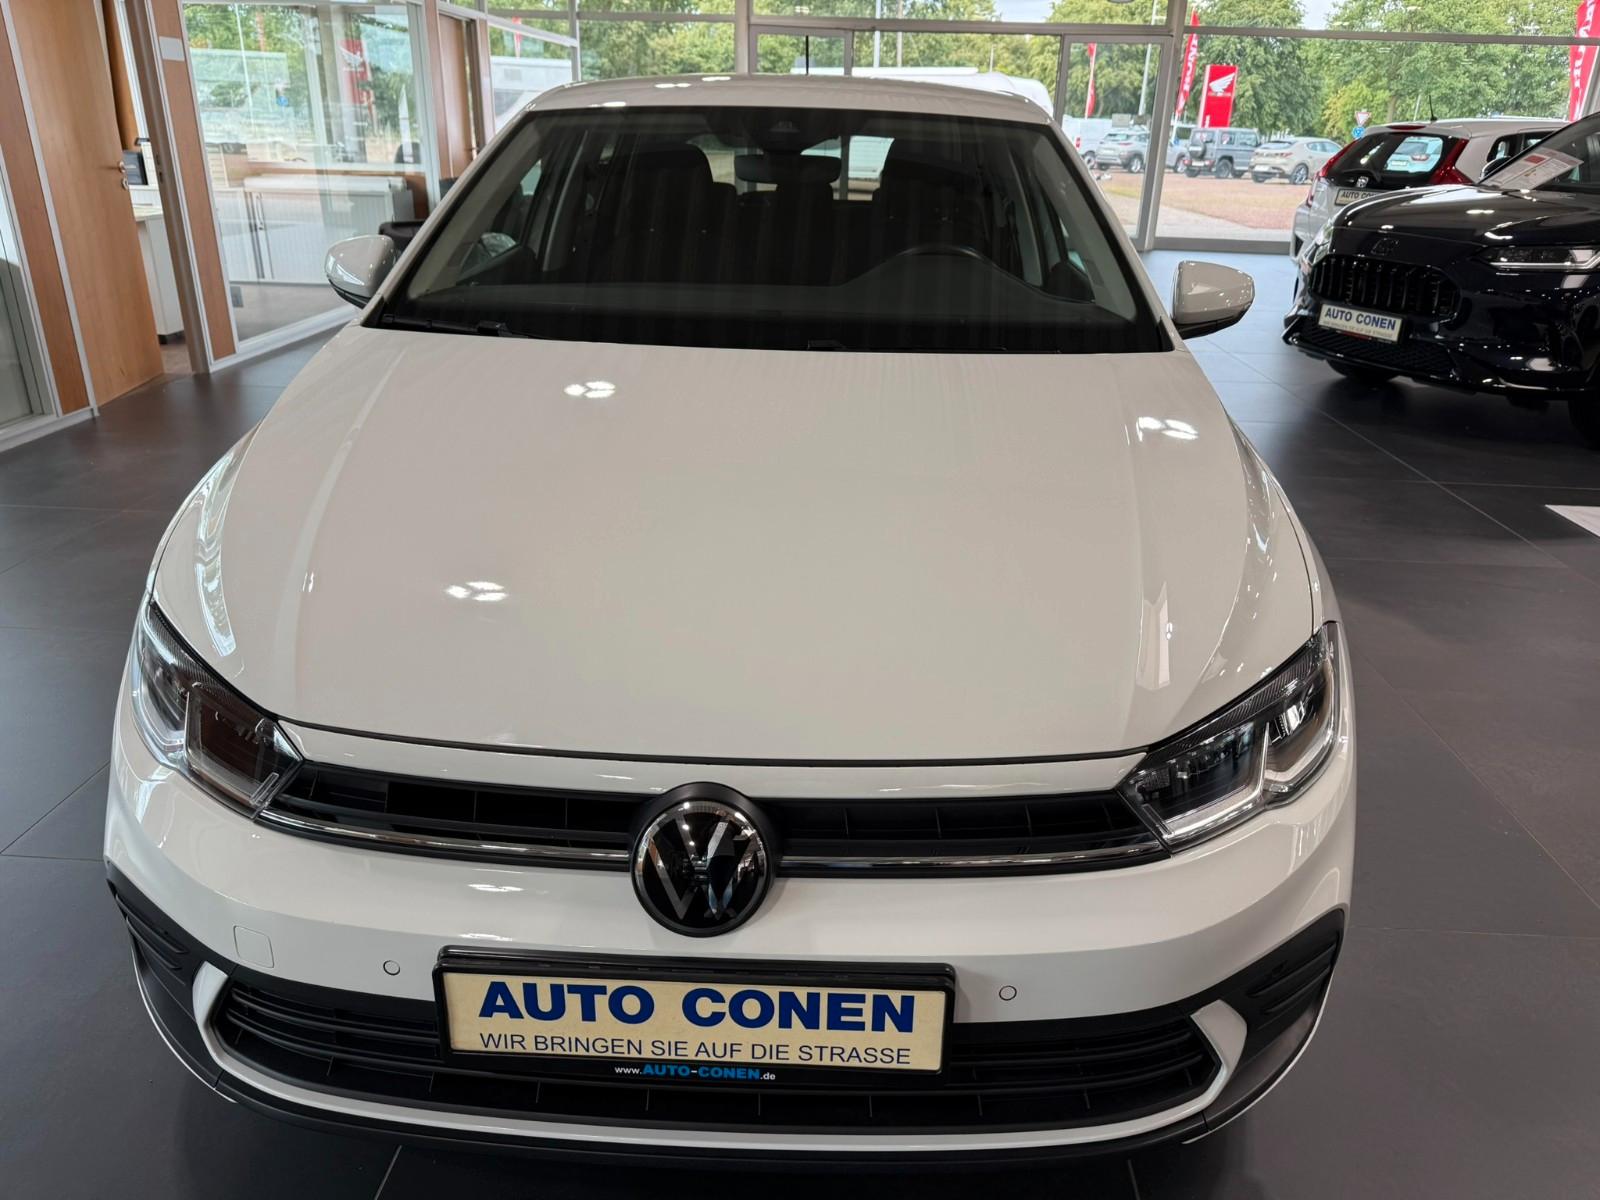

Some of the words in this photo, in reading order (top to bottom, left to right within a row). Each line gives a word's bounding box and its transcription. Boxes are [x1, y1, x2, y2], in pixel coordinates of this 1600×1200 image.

[1325, 308, 1352, 322] AUTO
[1355, 313, 1396, 331] CONEN
[479, 981, 655, 1025] AUTO
[682, 988, 915, 1033] CONEN
[480, 1032, 526, 1050] WIR
[534, 1034, 642, 1055] BRINGEN
[651, 1040, 689, 1057] SIE
[695, 1042, 743, 1059] AUF
[751, 1043, 789, 1061] DIE
[798, 1045, 911, 1065] STRASSE
[614, 1063, 776, 1081] www.AUTO-CONEN.de
